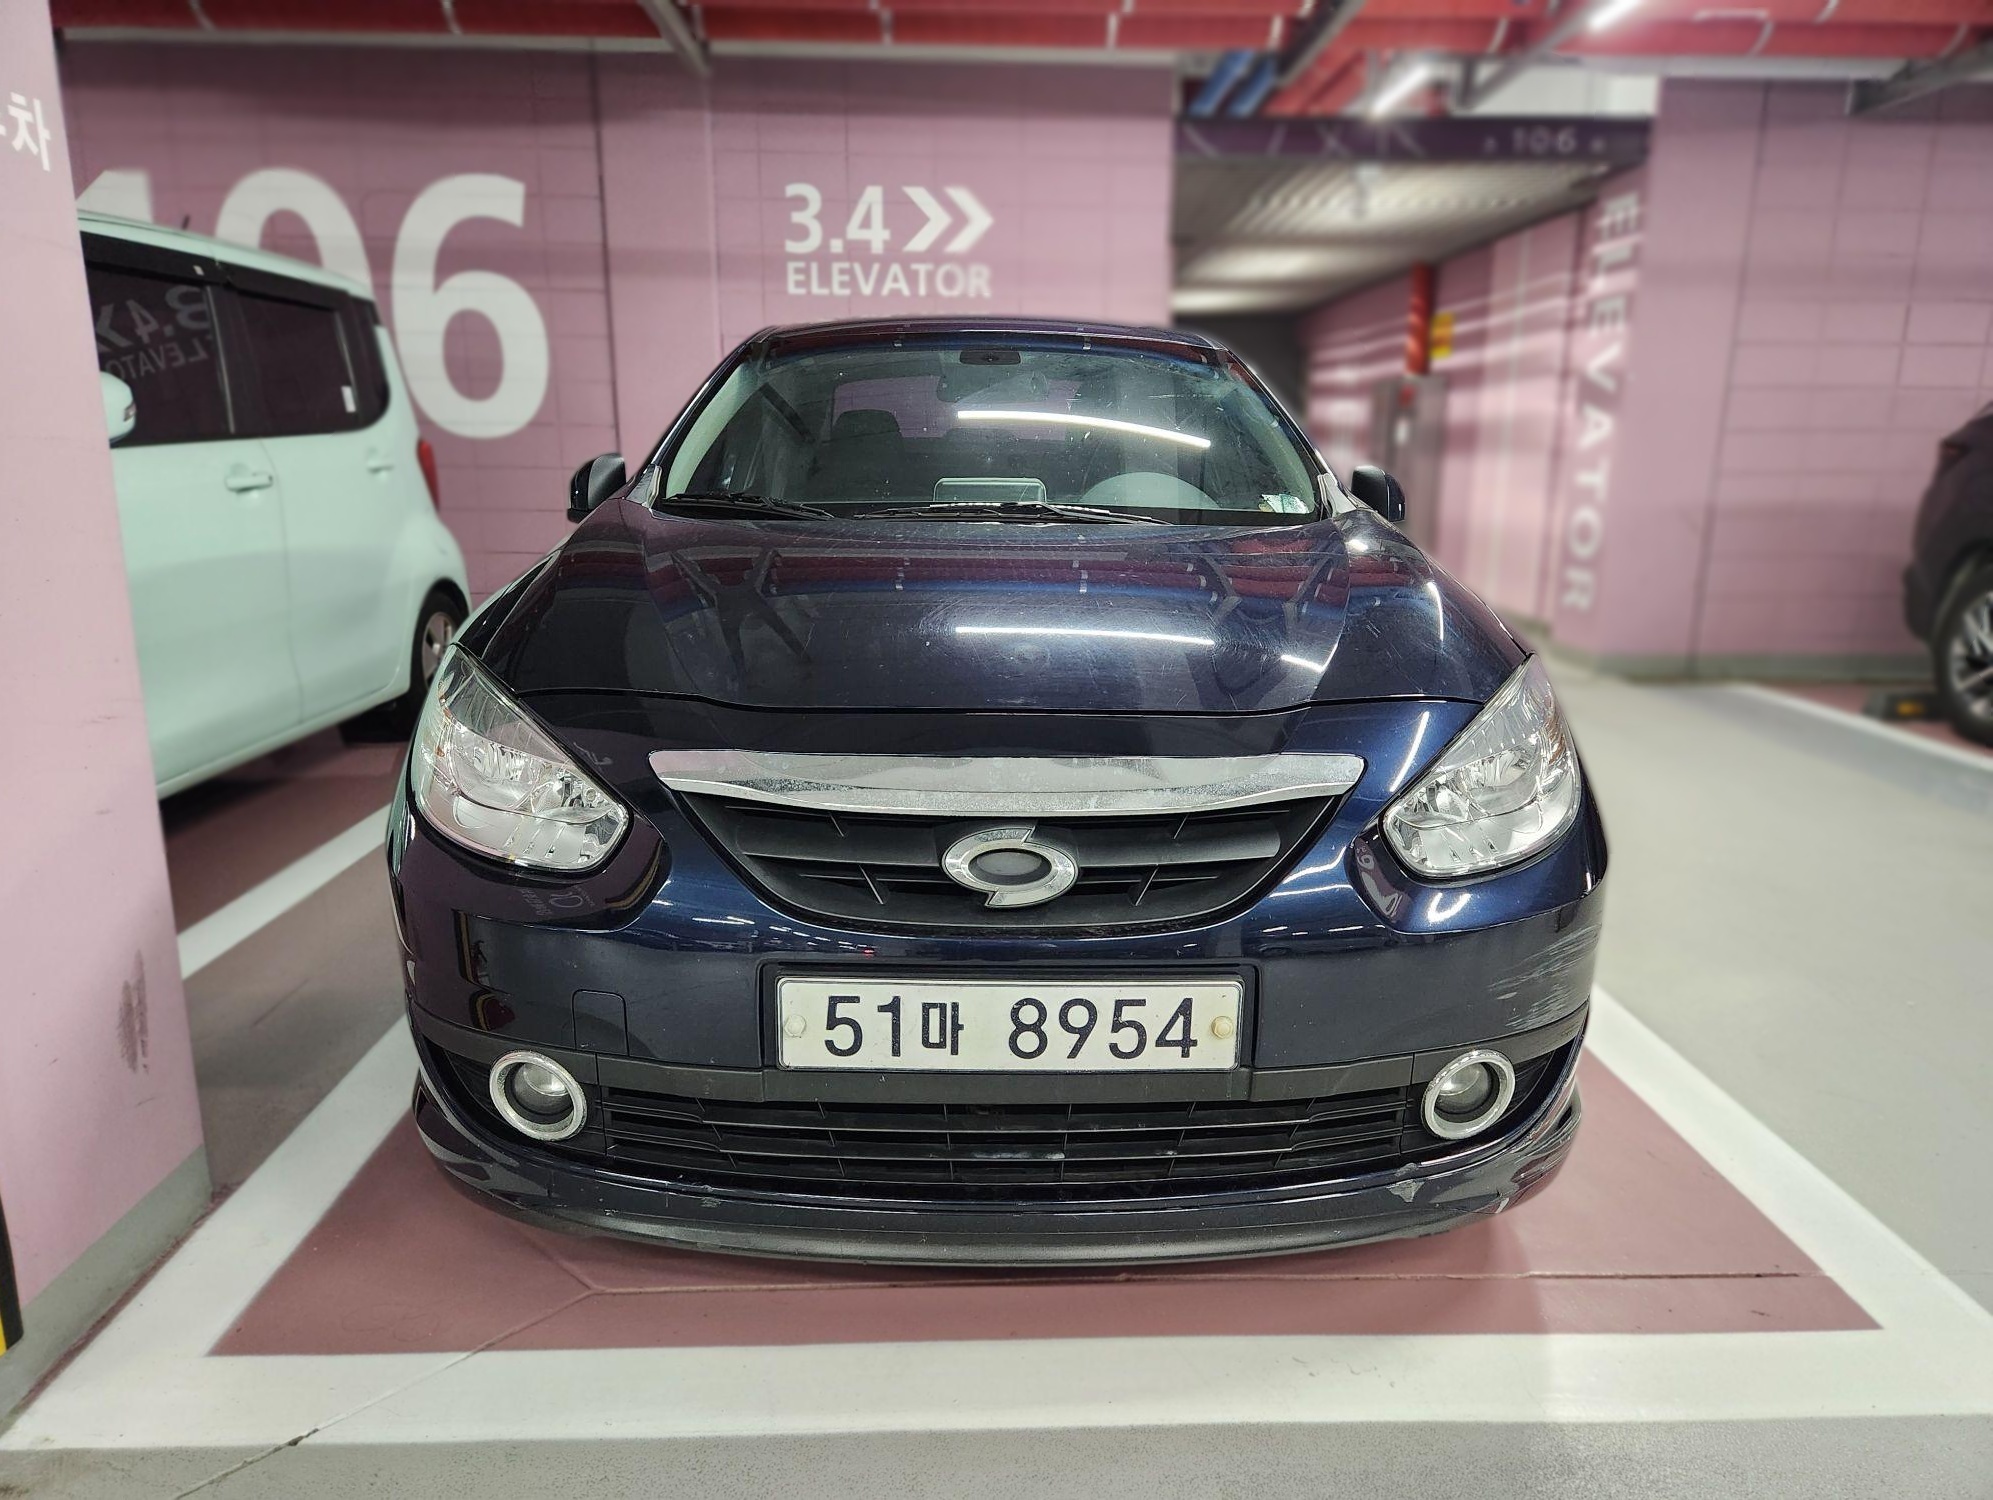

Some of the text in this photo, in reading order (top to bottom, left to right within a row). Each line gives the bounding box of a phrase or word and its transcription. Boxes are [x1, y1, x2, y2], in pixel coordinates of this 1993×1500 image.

[0, 91, 52, 172] 차
[1511, 125, 1577, 155] 106
[784, 182, 891, 255] 3.4
[786, 261, 992, 298] ELEVATOR
[1561, 192, 1640, 611] ELEVATOR
[823, 995, 1198, 1060] 51마 8954
